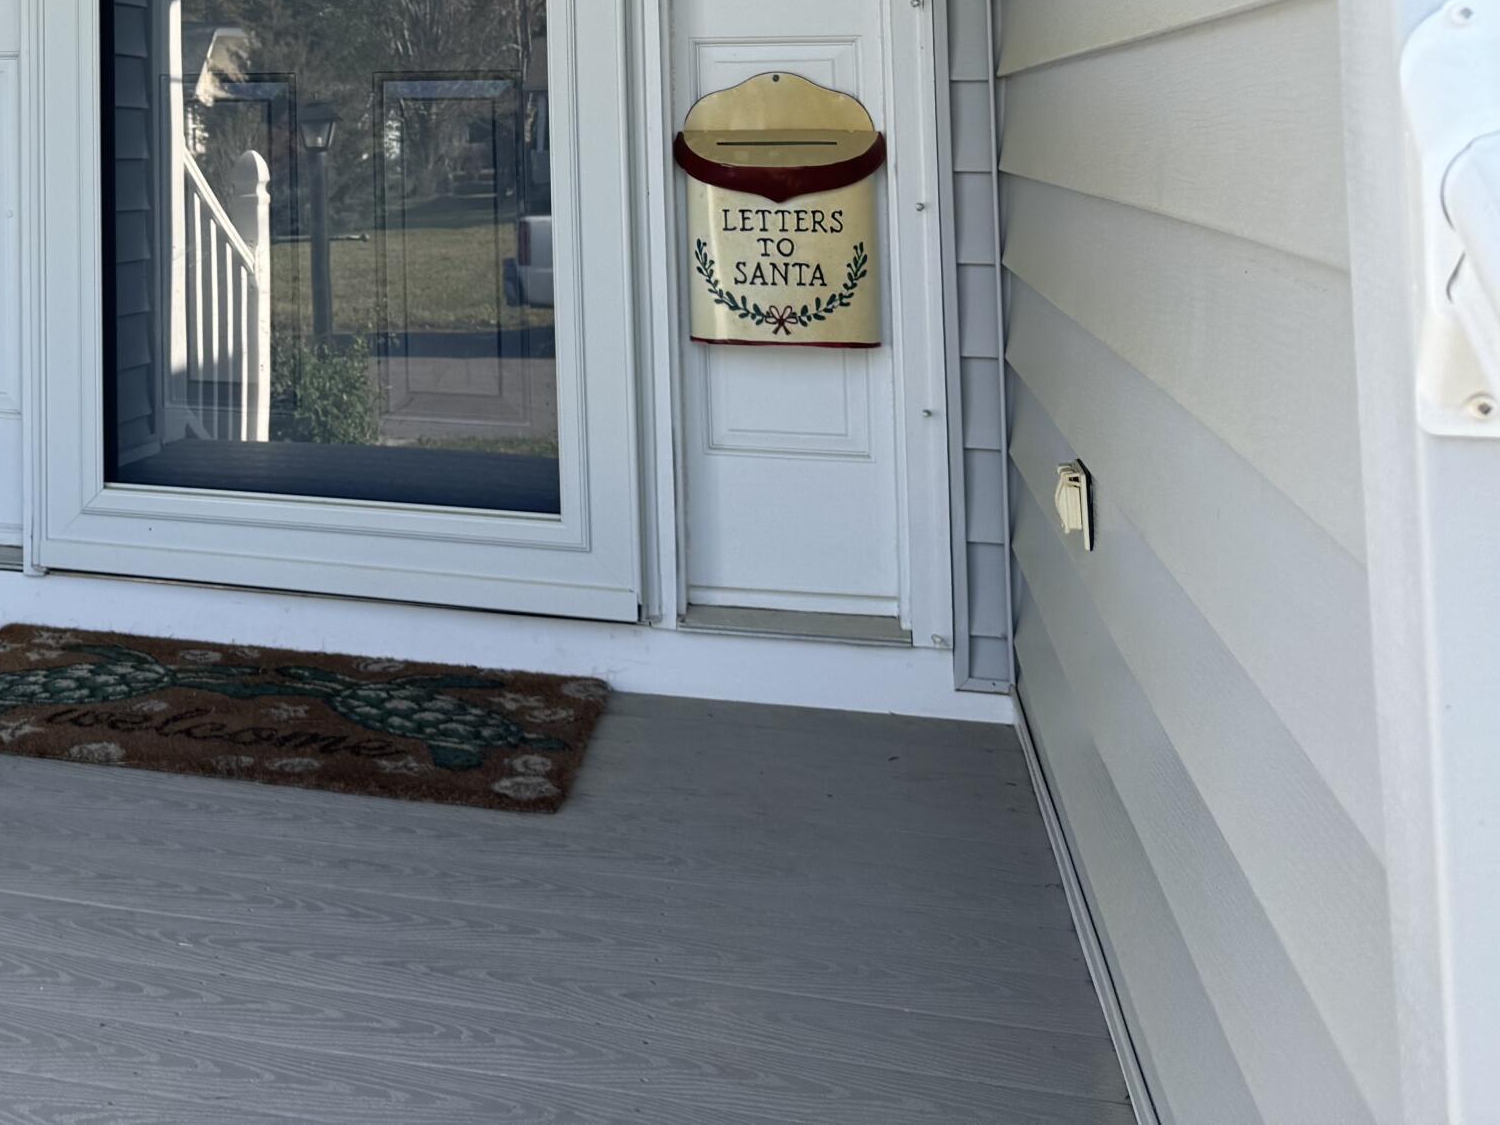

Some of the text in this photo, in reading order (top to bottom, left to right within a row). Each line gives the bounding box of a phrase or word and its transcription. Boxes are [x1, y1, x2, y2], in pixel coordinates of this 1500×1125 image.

[721, 208, 845, 234] LETTERS
[756, 237, 796, 258] TO
[733, 261, 828, 287] SANTA
[44, 706, 407, 757] welcome
